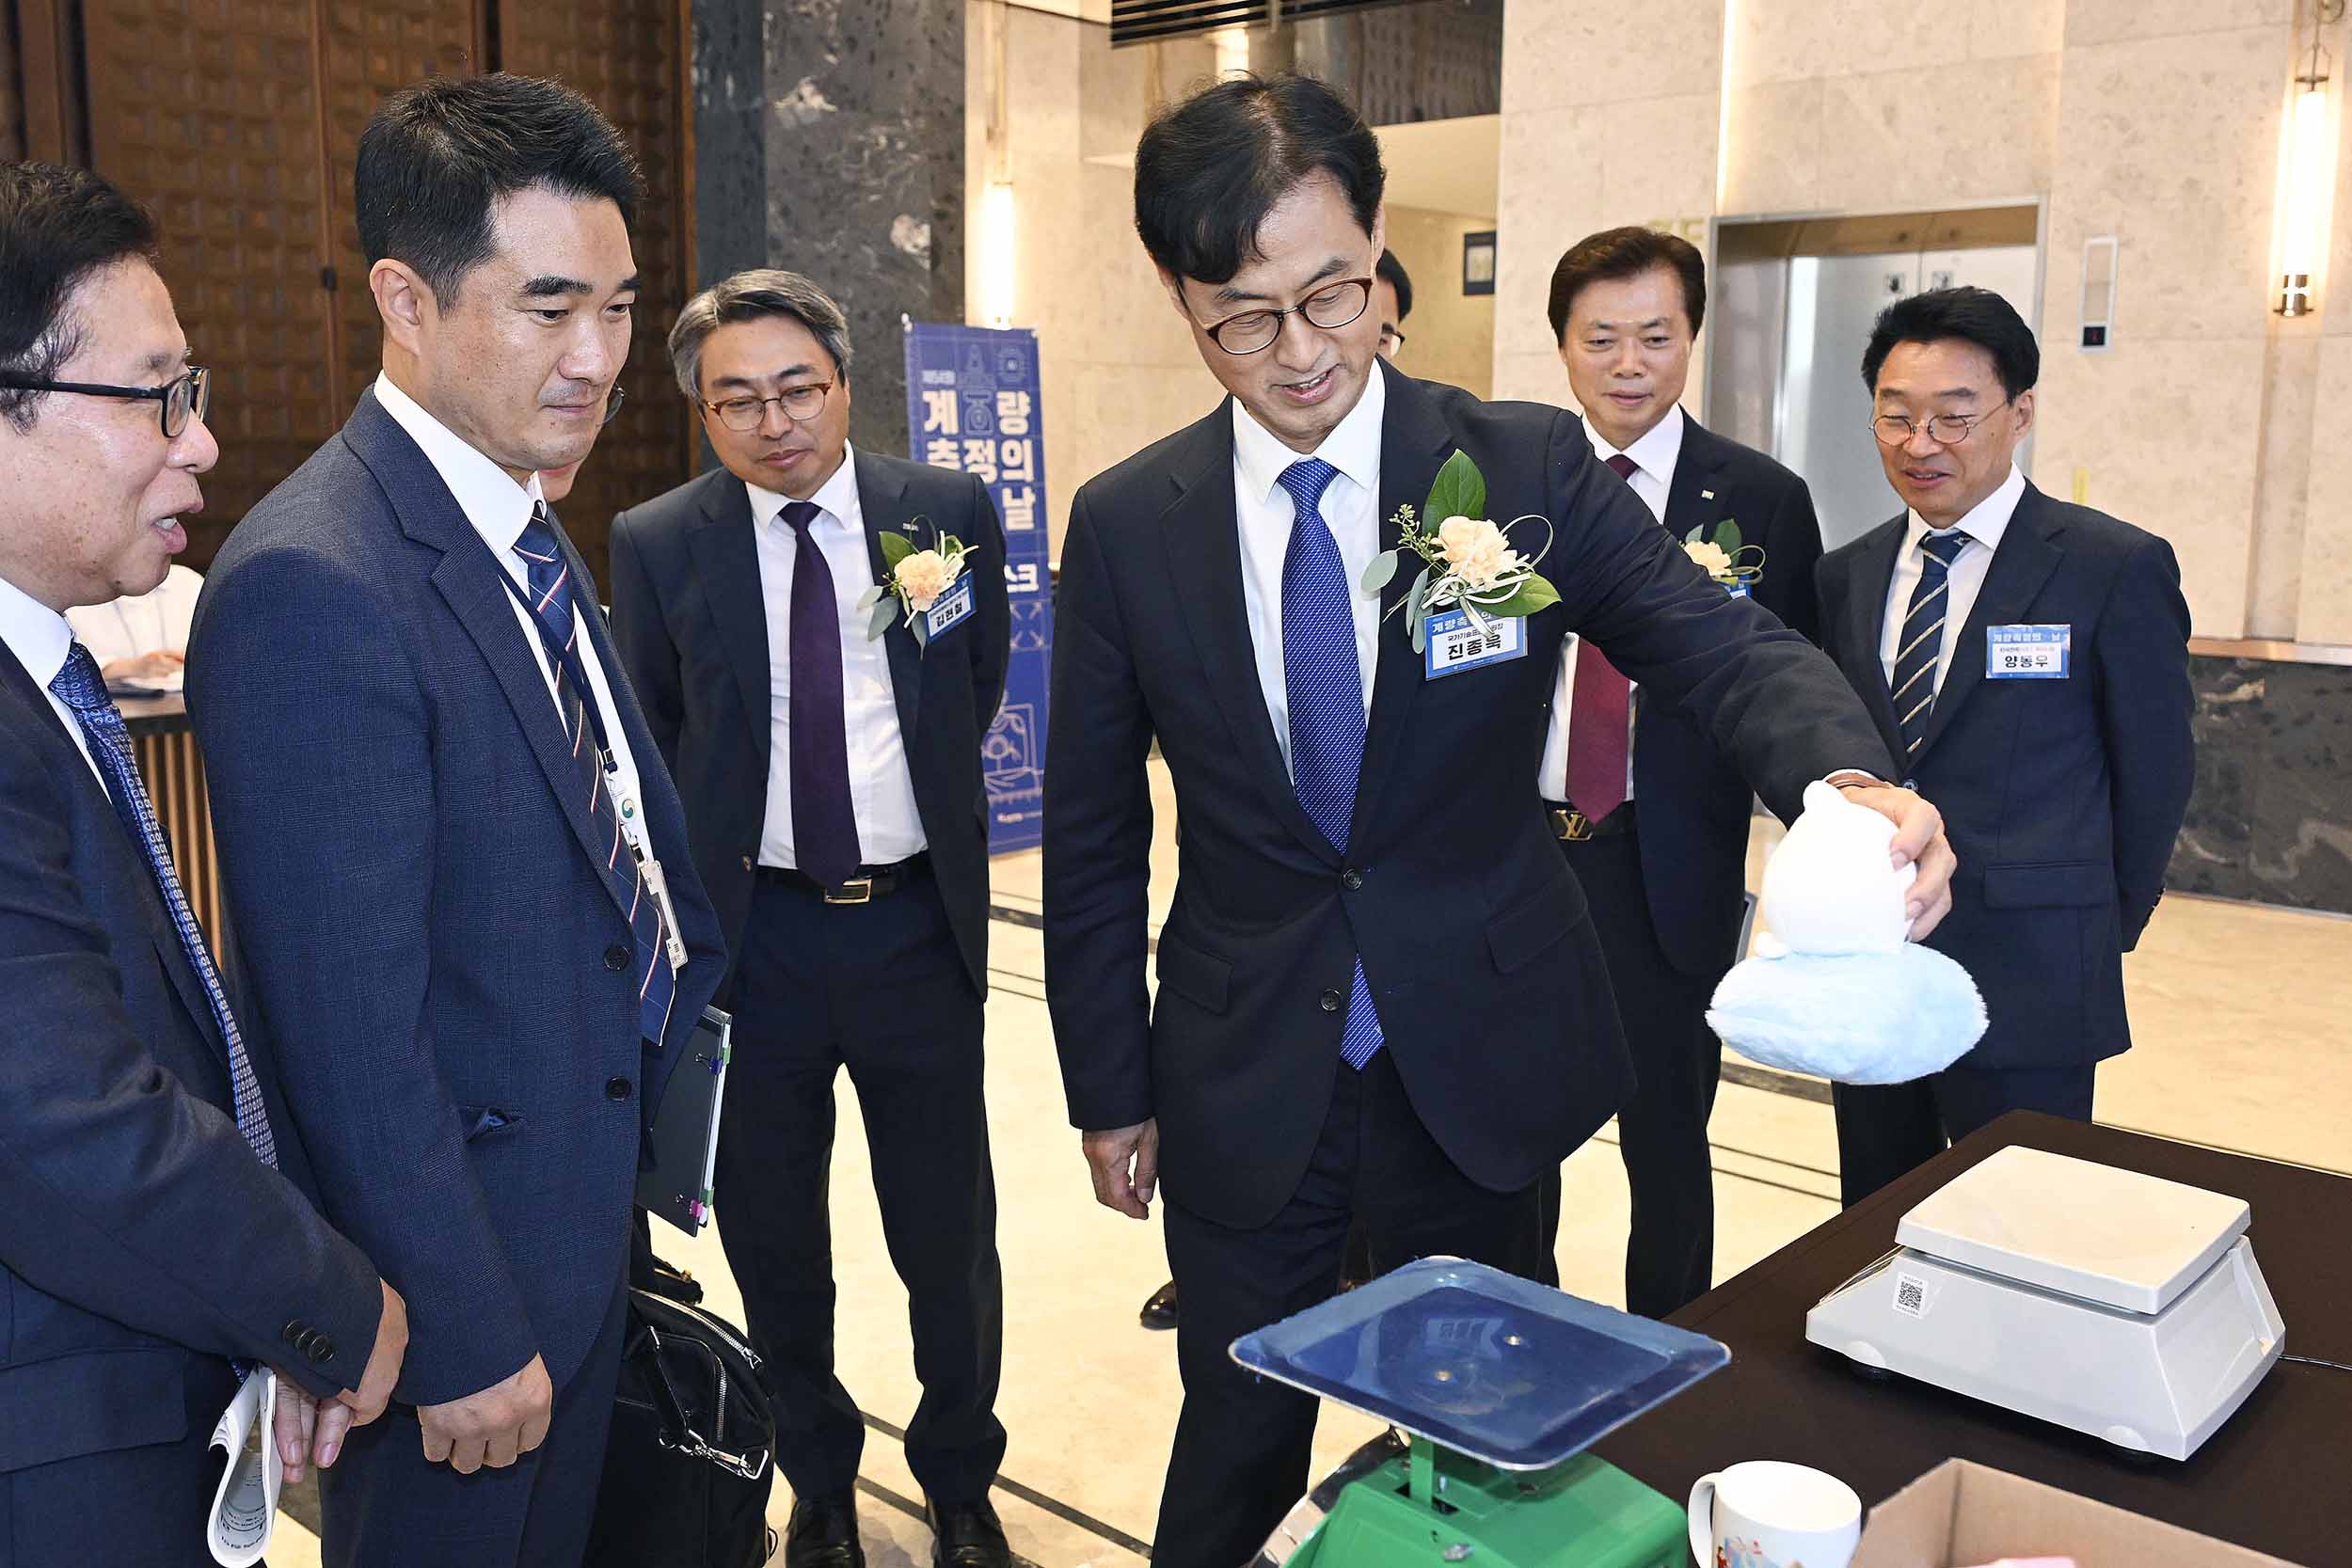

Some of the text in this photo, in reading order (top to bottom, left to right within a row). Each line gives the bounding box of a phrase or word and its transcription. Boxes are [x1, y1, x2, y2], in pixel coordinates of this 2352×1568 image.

[1001, 486, 1036, 531] 날
[1432, 610, 1492, 633] 계량측의
[1448, 633, 1502, 661] 진종욱
[2005, 655, 2048, 669] 양동우
